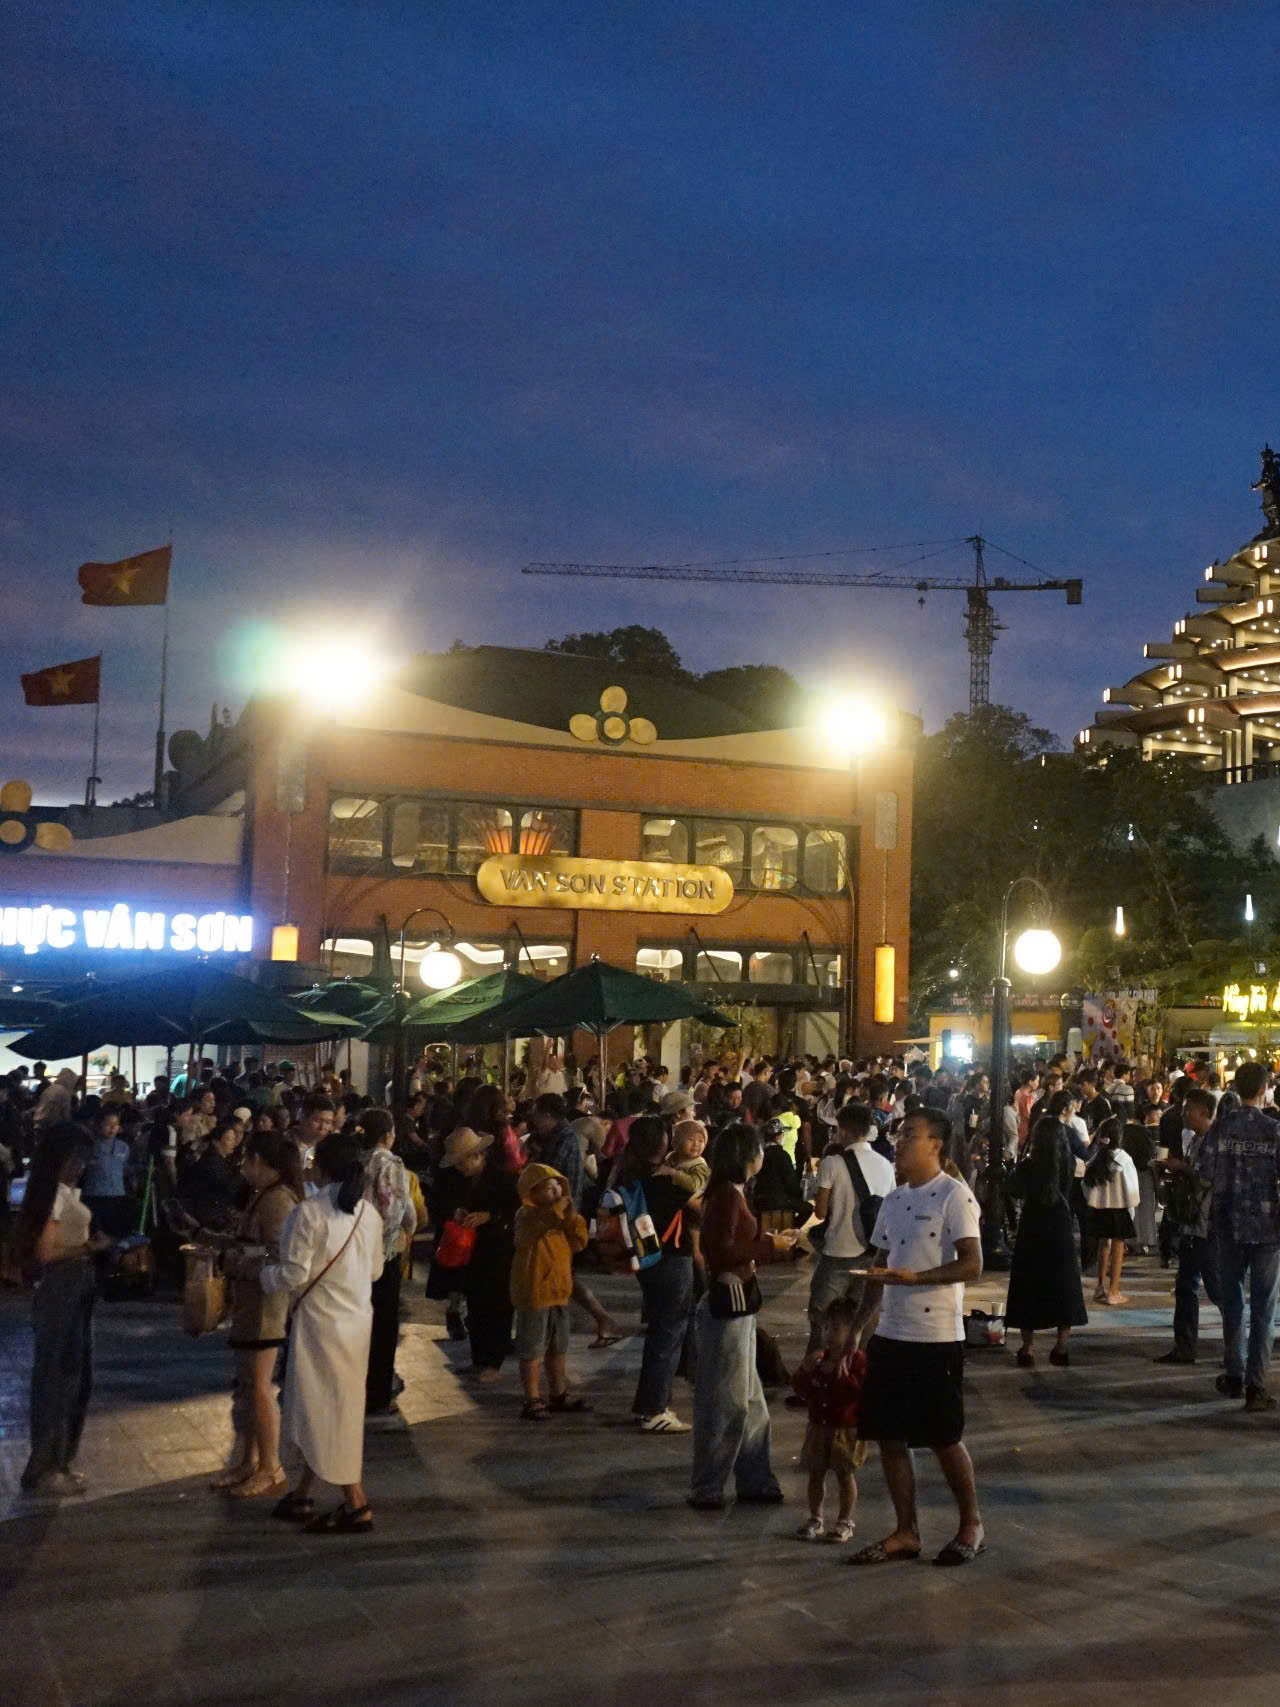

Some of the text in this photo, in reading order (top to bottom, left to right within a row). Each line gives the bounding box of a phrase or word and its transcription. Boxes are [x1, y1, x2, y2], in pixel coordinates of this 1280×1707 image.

[500, 868, 716, 900] VAN SON STATION
[83, 903, 165, 949] VÂN
[170, 911, 253, 951] SƠN
